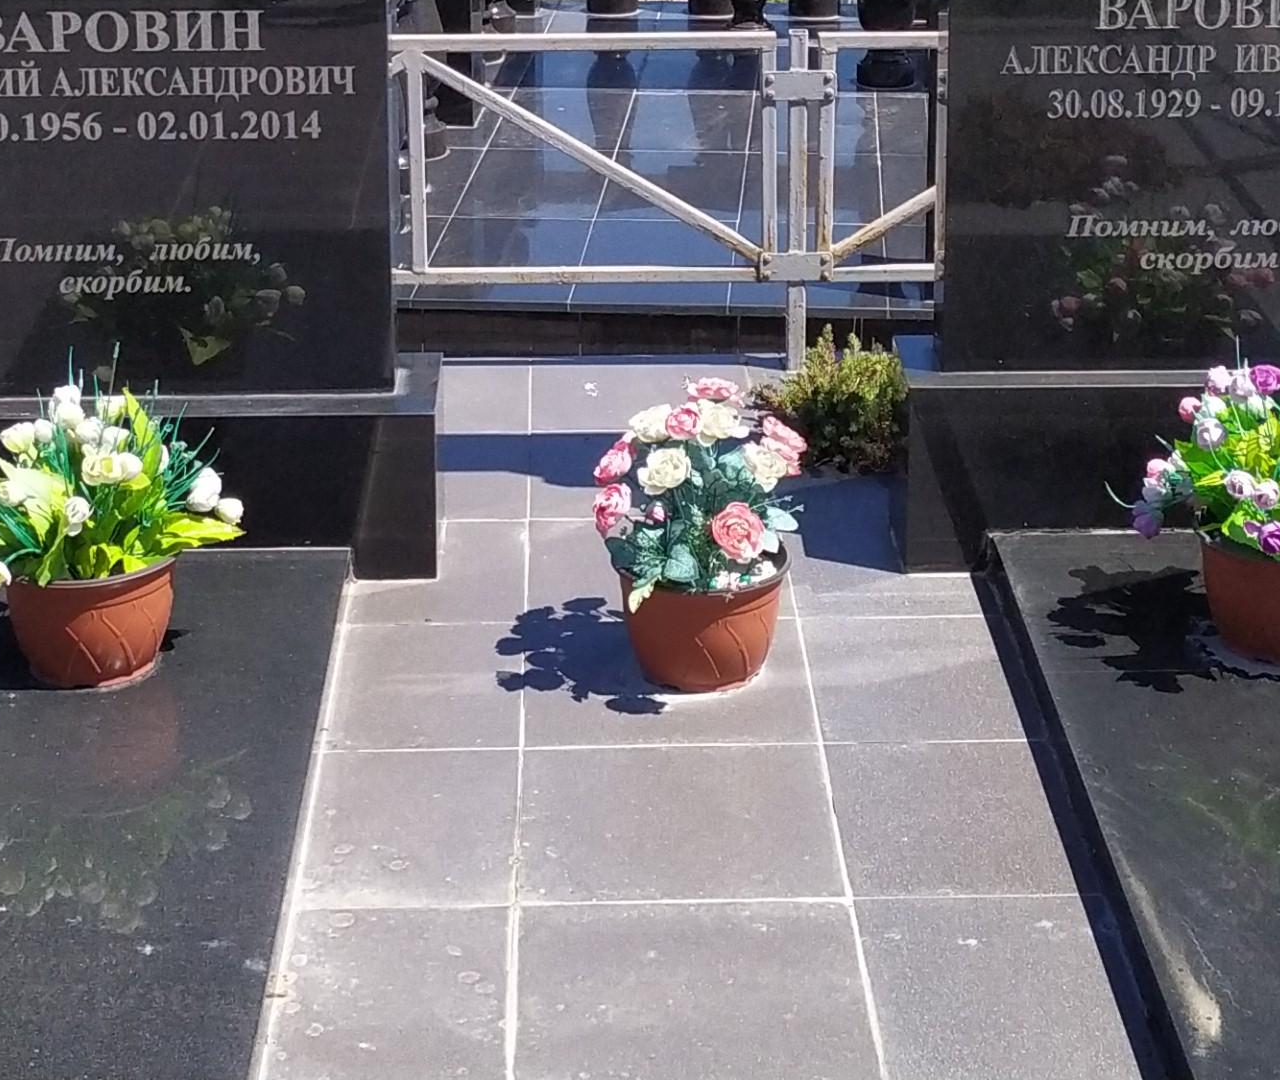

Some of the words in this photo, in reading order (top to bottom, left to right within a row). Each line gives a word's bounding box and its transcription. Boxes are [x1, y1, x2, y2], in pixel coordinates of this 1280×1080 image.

[999, 44, 1217, 81] АЛЕКСАНДР
[49, 65, 356, 103] АЛЕКСАНДРОВИЧ
[1046, 88, 1202, 119] 30.08.1929
[136, 109, 322, 141] 02.01.2014
[1065, 214, 1217, 242] Помним,
[148, 238, 261, 265] любим,
[1140, 247, 1279, 274] скорбим
[59, 268, 192, 300] скорбим.
